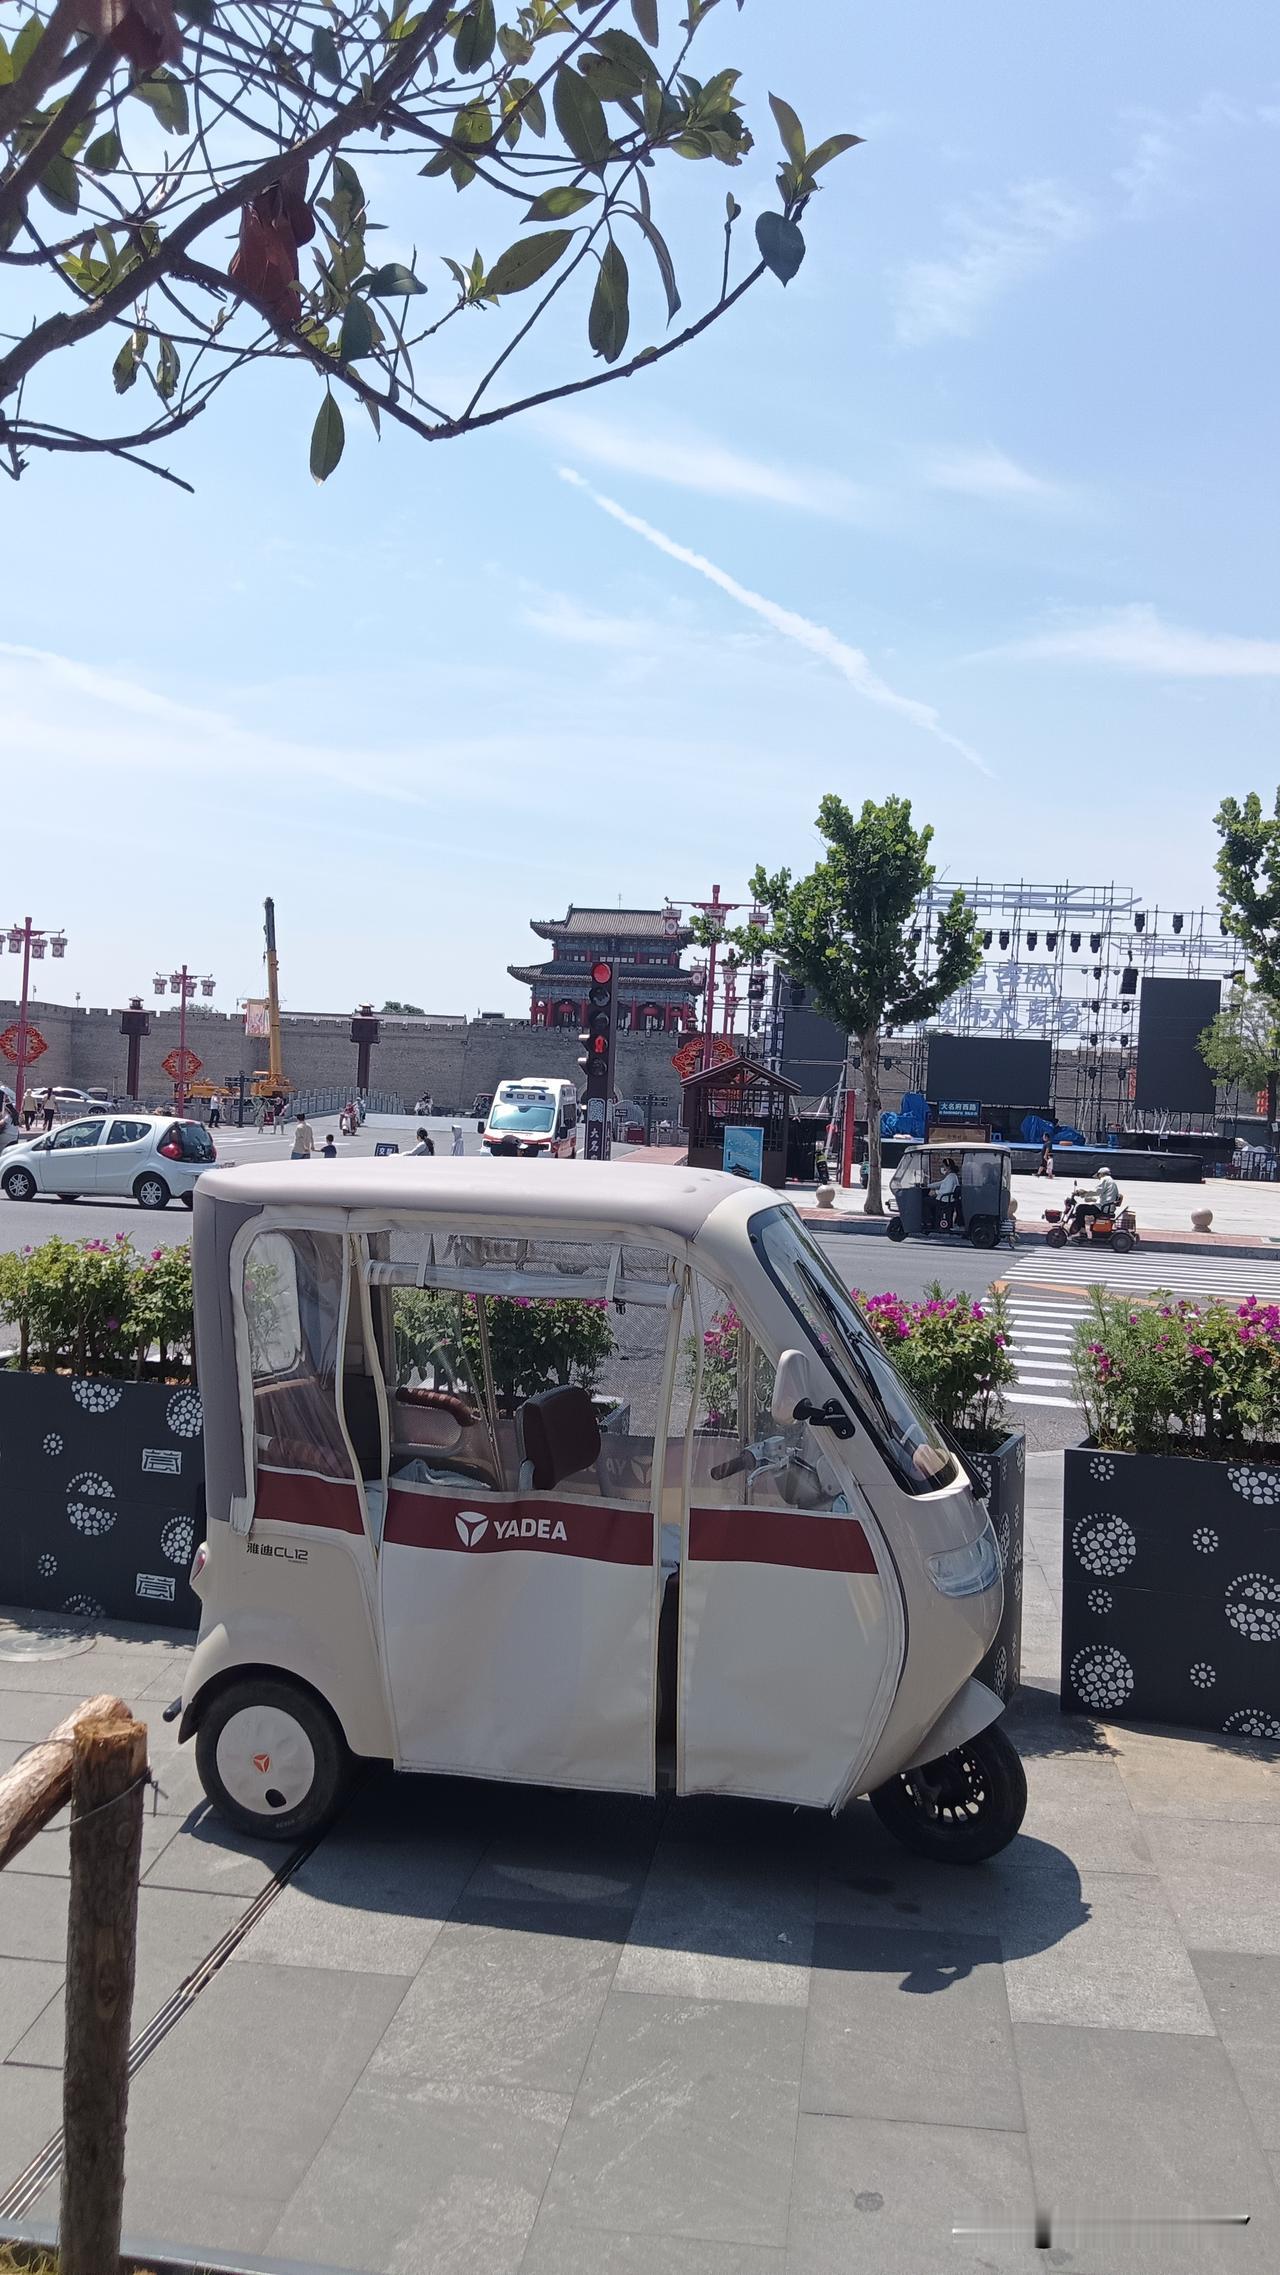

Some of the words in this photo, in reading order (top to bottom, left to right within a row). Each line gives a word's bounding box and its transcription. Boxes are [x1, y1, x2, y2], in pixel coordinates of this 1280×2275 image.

[940, 1102, 977, 1111] 大名府西路
[493, 1518, 568, 1541] YADEA
